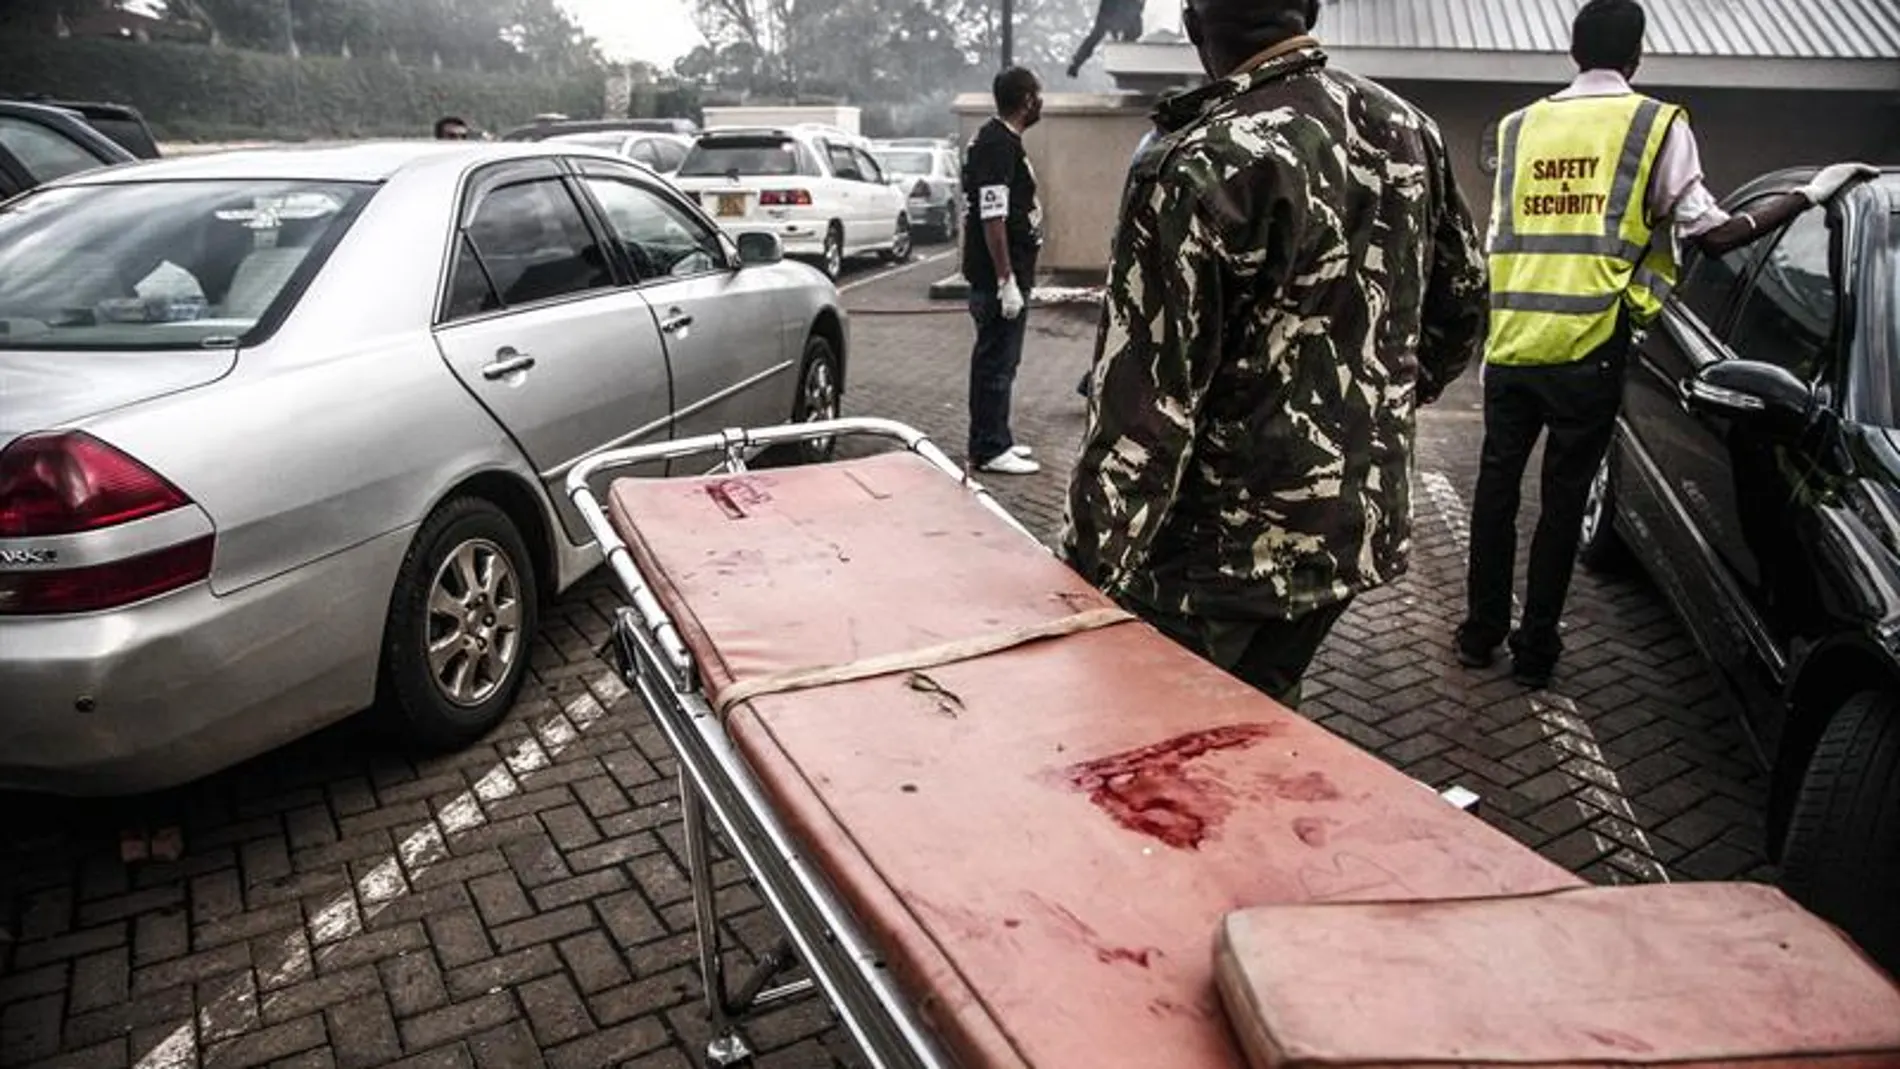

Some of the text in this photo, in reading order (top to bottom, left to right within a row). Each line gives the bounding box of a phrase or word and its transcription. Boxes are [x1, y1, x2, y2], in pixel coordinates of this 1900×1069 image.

[1533, 157, 1599, 181] SAFETY
[1561, 181, 1570, 192] &
[1523, 194, 1606, 216] SECURITY
